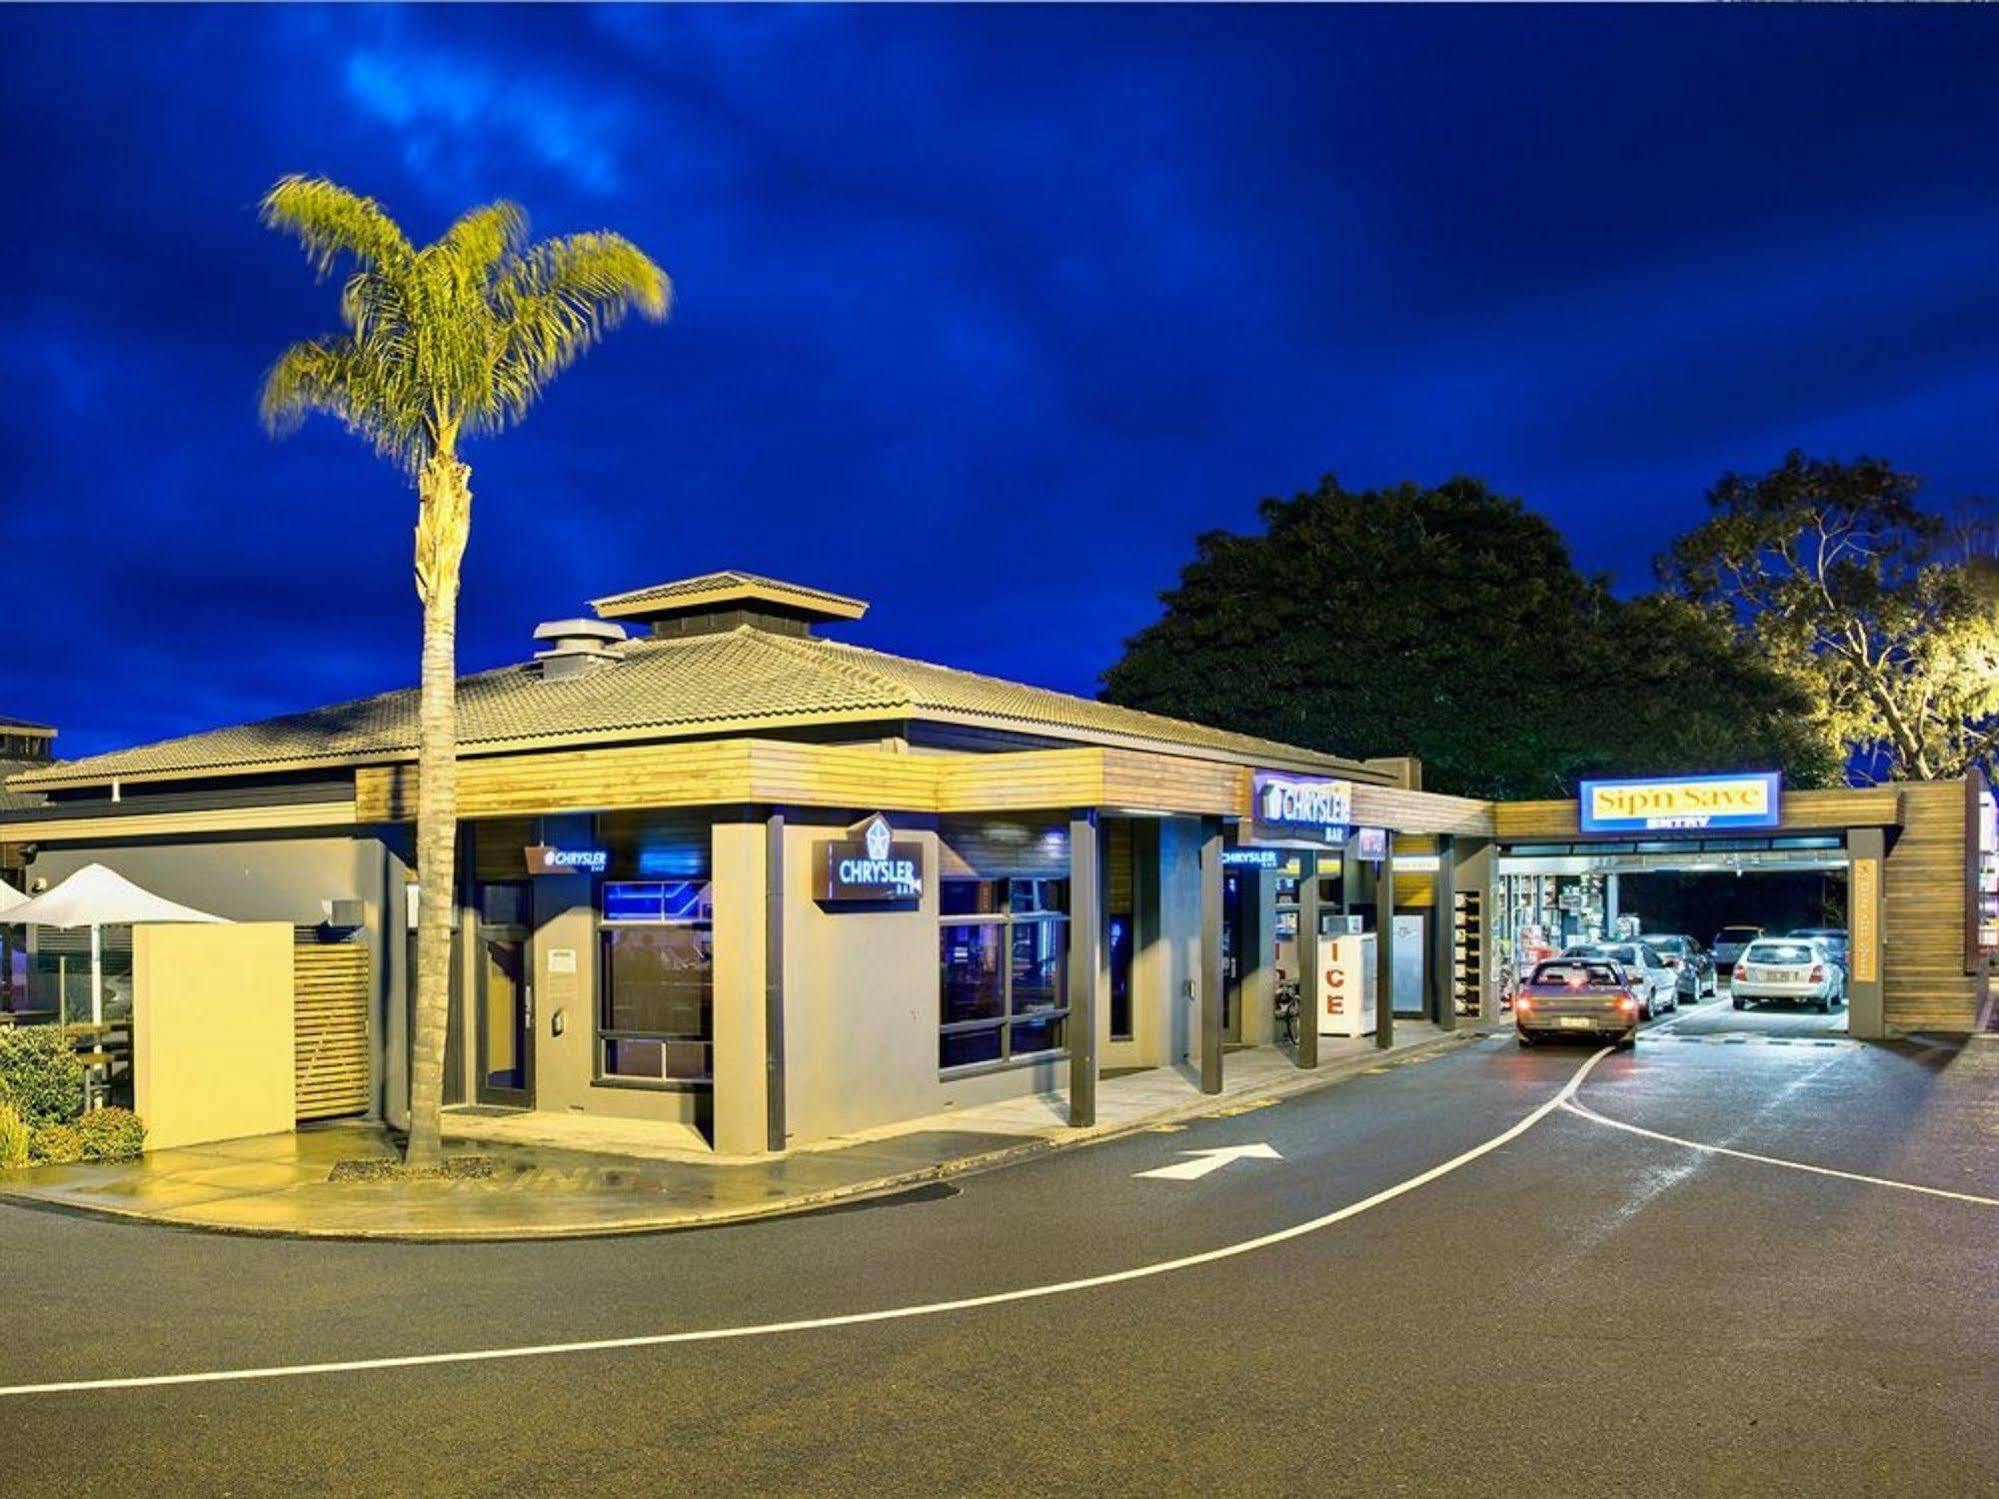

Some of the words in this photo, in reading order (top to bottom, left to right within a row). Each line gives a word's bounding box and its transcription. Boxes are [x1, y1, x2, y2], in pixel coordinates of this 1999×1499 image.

[1283, 786, 1350, 824] CHRYSLER
[1683, 786, 1761, 809] Save
[1325, 826, 1343, 842] BAR
[555, 851, 606, 866] CHRYSLER
[839, 859, 915, 884] CHRYSLER
[1325, 942, 1345, 1015] ICE
